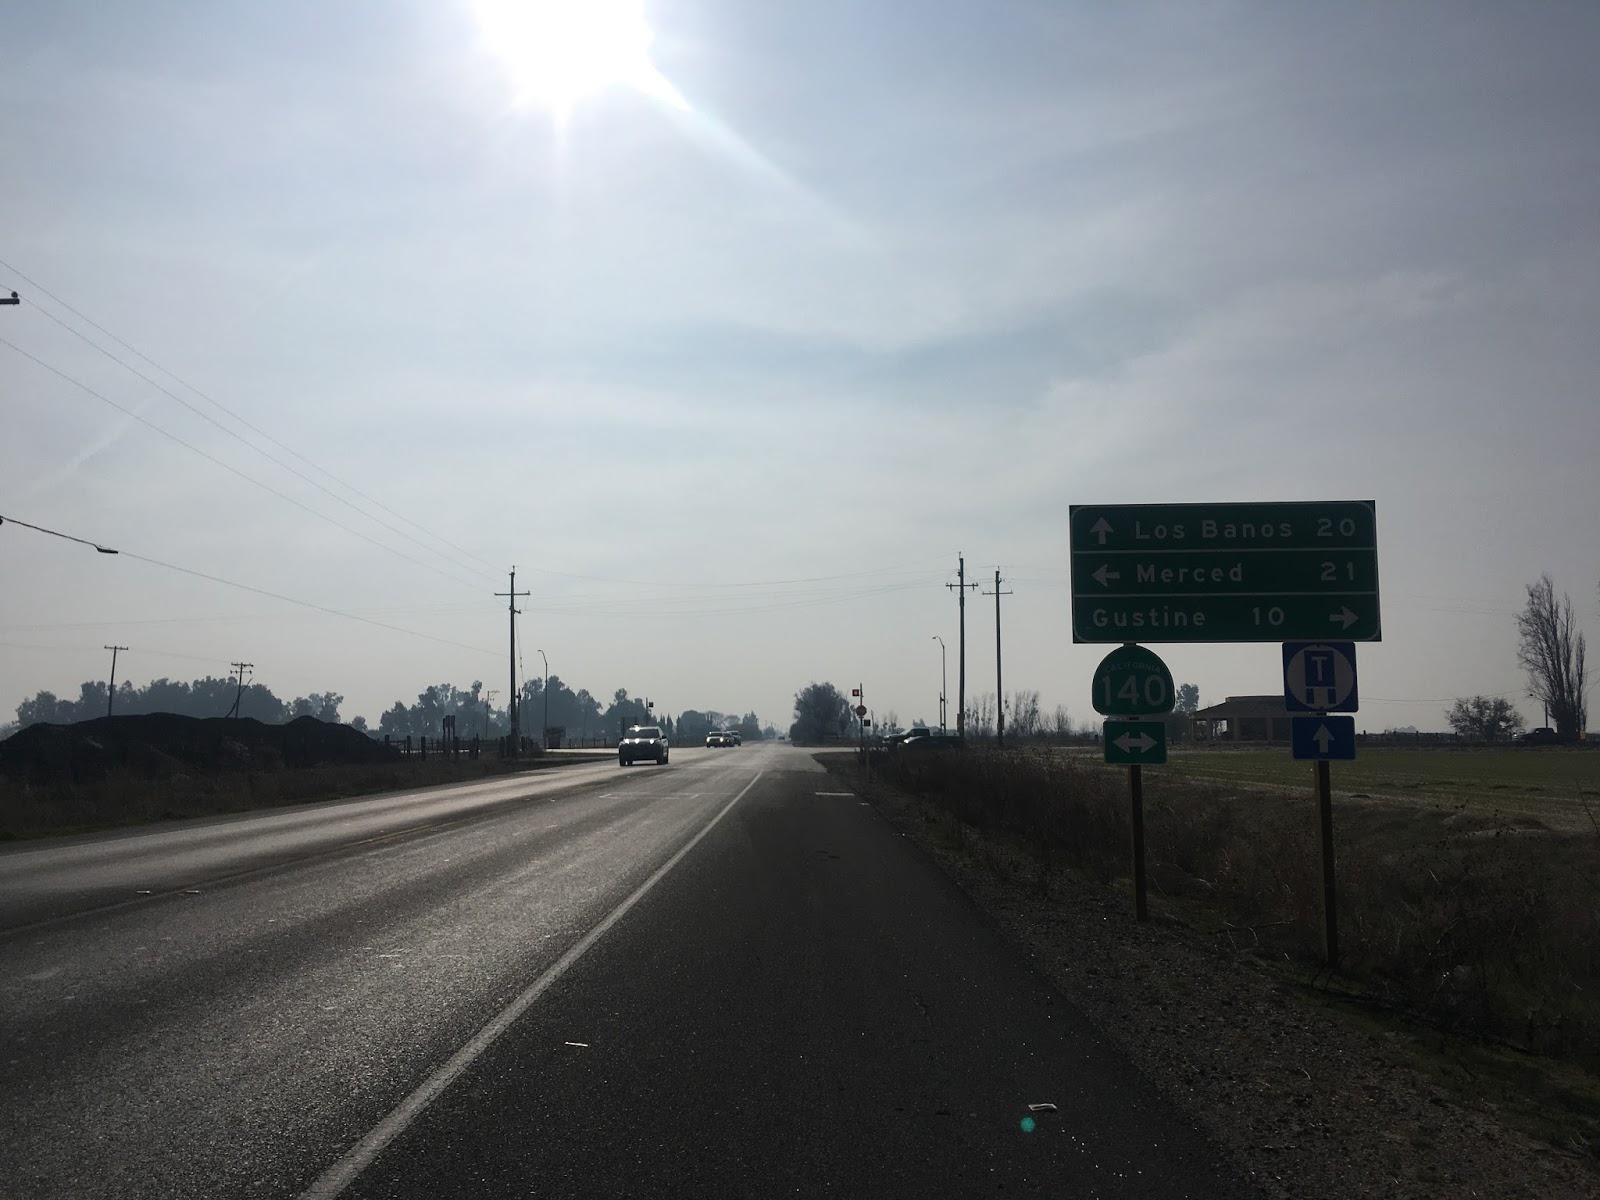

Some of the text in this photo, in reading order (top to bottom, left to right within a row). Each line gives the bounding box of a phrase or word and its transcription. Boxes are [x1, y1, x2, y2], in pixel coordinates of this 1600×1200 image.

[1135, 518, 1356, 540] Los Banos 20
[1136, 561, 1355, 583] Merced 21
[1092, 605, 1286, 627] Gustine 10
[1104, 662, 1161, 673] CALIFORNIA
[1311, 656, 1328, 681] T
[1102, 674, 1167, 706] 140
